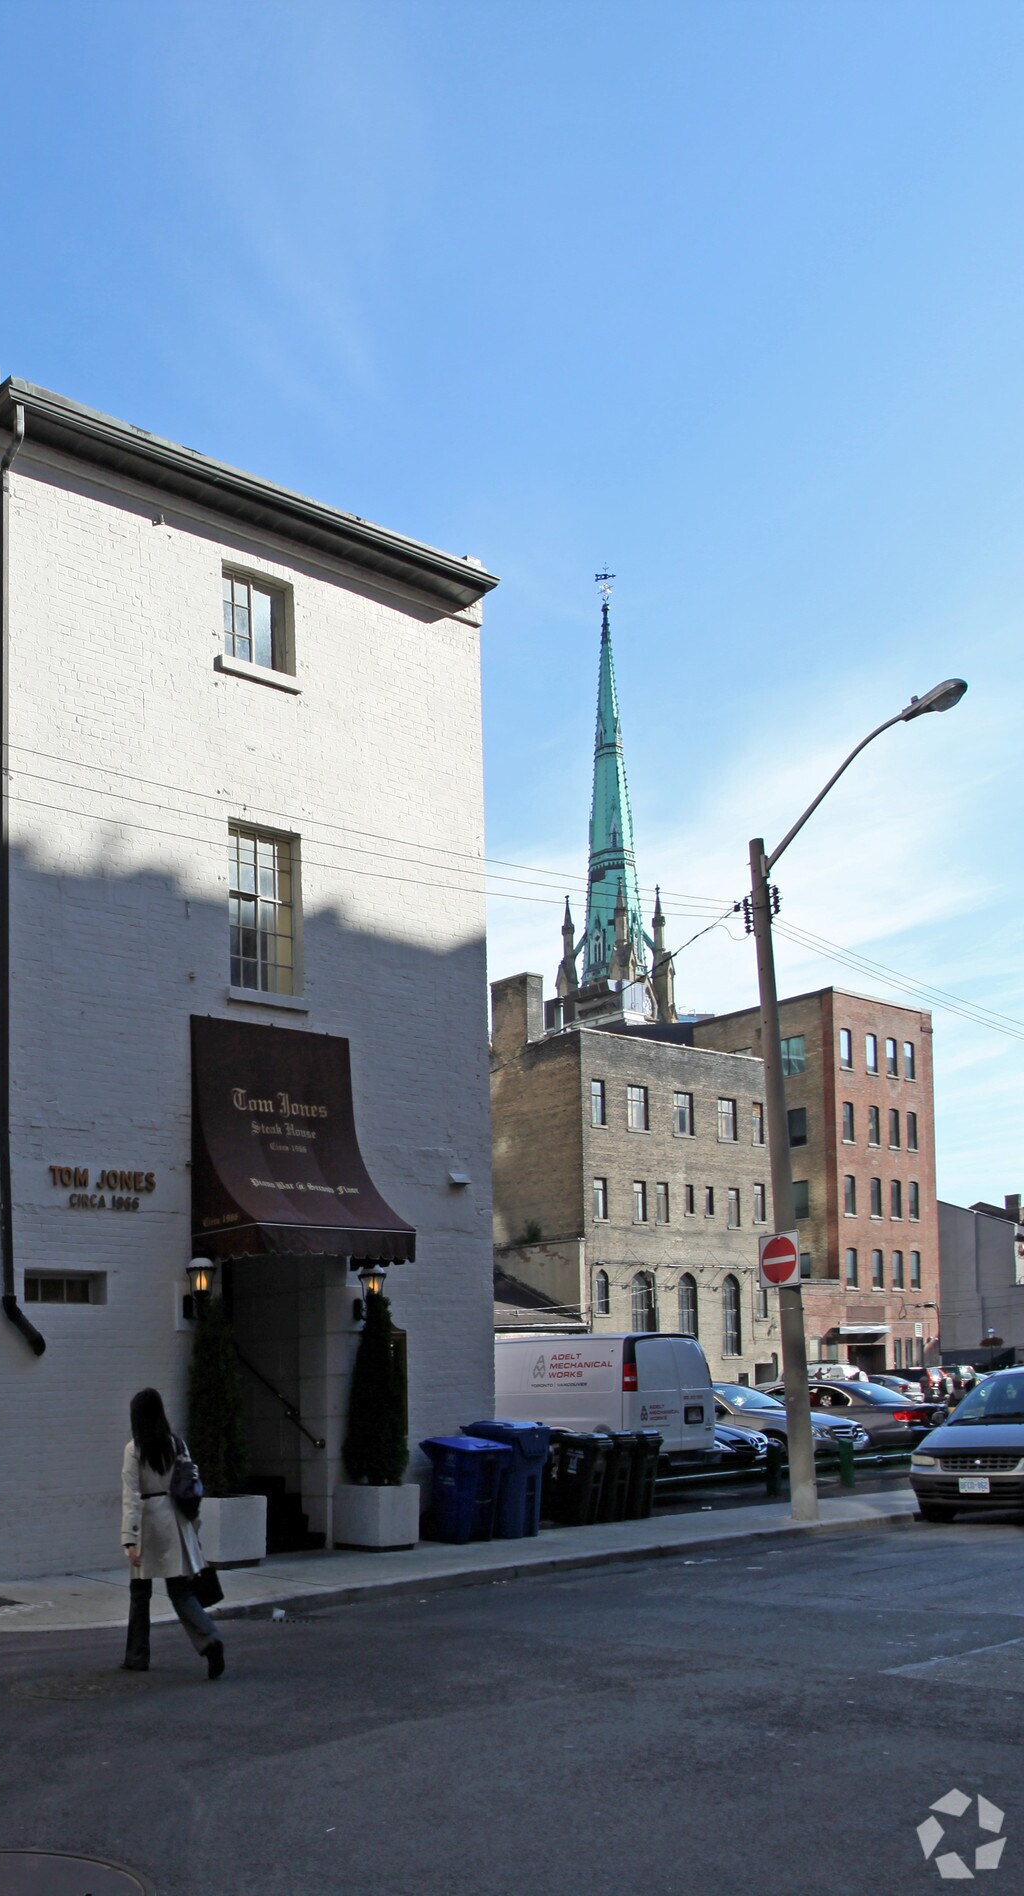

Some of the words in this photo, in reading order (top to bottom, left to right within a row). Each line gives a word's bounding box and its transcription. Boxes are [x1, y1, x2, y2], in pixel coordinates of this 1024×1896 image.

[231, 1087, 274, 1113] Tom
[276, 1092, 328, 1118] Jones
[251, 1121, 282, 1136] Steak
[285, 1123, 316, 1139] House
[269, 1142, 289, 1151] Circa
[291, 1144, 307, 1153] 1966
[49, 1165, 89, 1188] TOM
[96, 1169, 156, 1193] JONES
[69, 1193, 106, 1209] CIRCA
[111, 1195, 140, 1211] 1966
[550, 1353, 582, 1361] ADELT
[549, 1361, 613, 1370] MECHANICAL
[548, 1371, 583, 1379] WORKS
